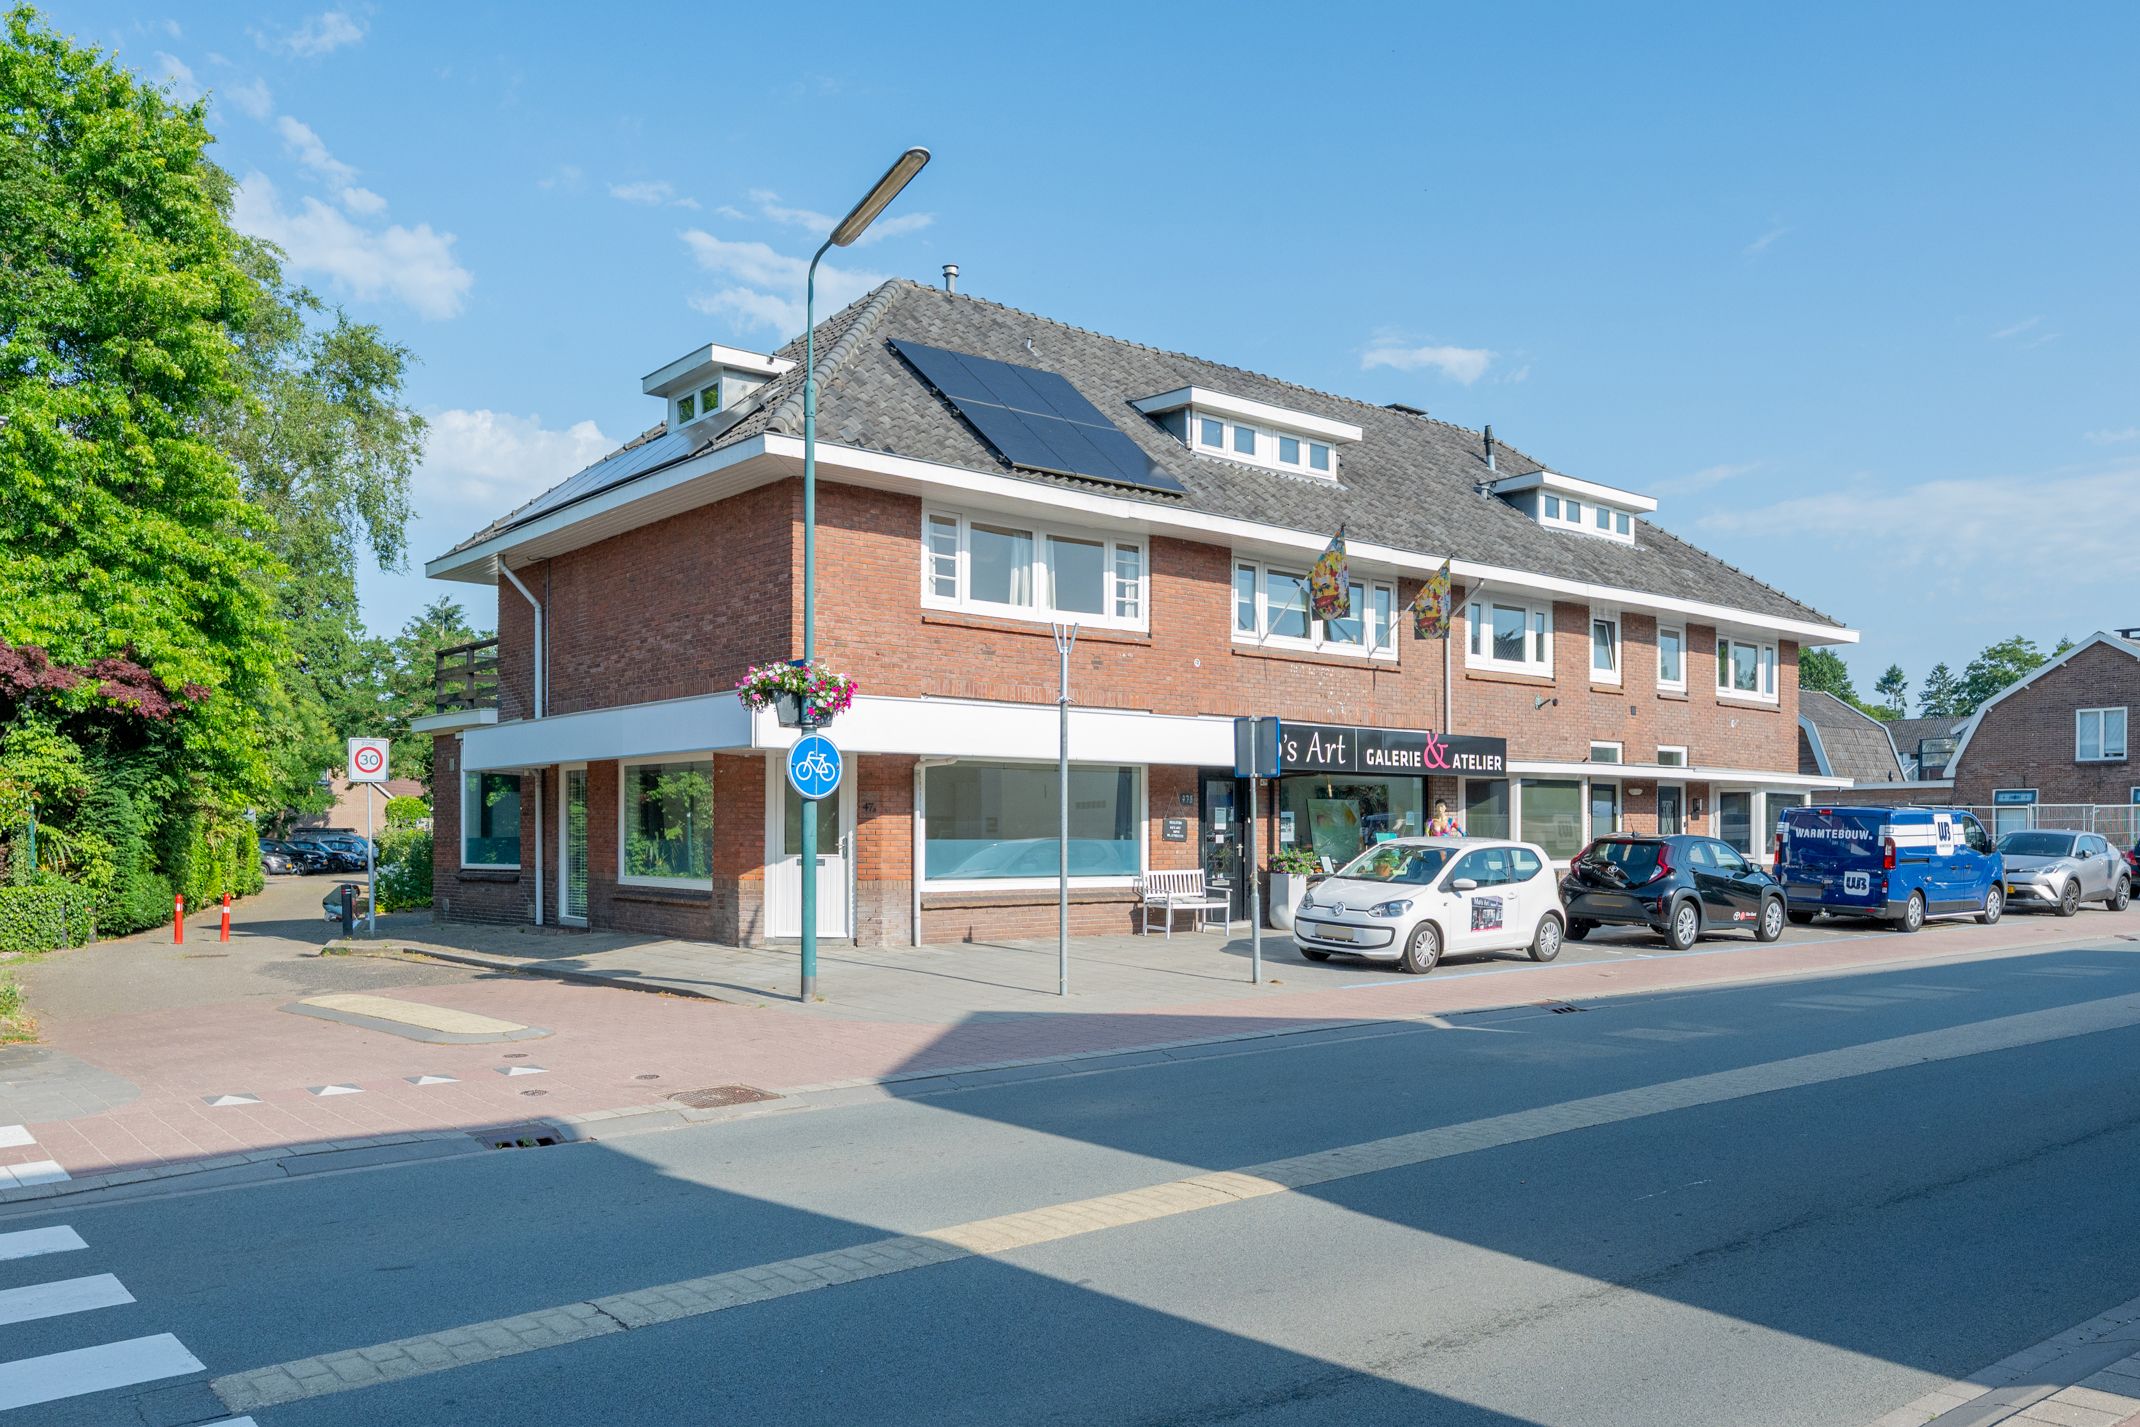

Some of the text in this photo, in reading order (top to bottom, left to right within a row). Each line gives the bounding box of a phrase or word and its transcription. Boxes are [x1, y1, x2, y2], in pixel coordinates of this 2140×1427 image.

[360, 754, 379, 766] 30
[1280, 731, 1346, 764] 's Art
[1366, 732, 1502, 771] GALERIE & ATELIER
